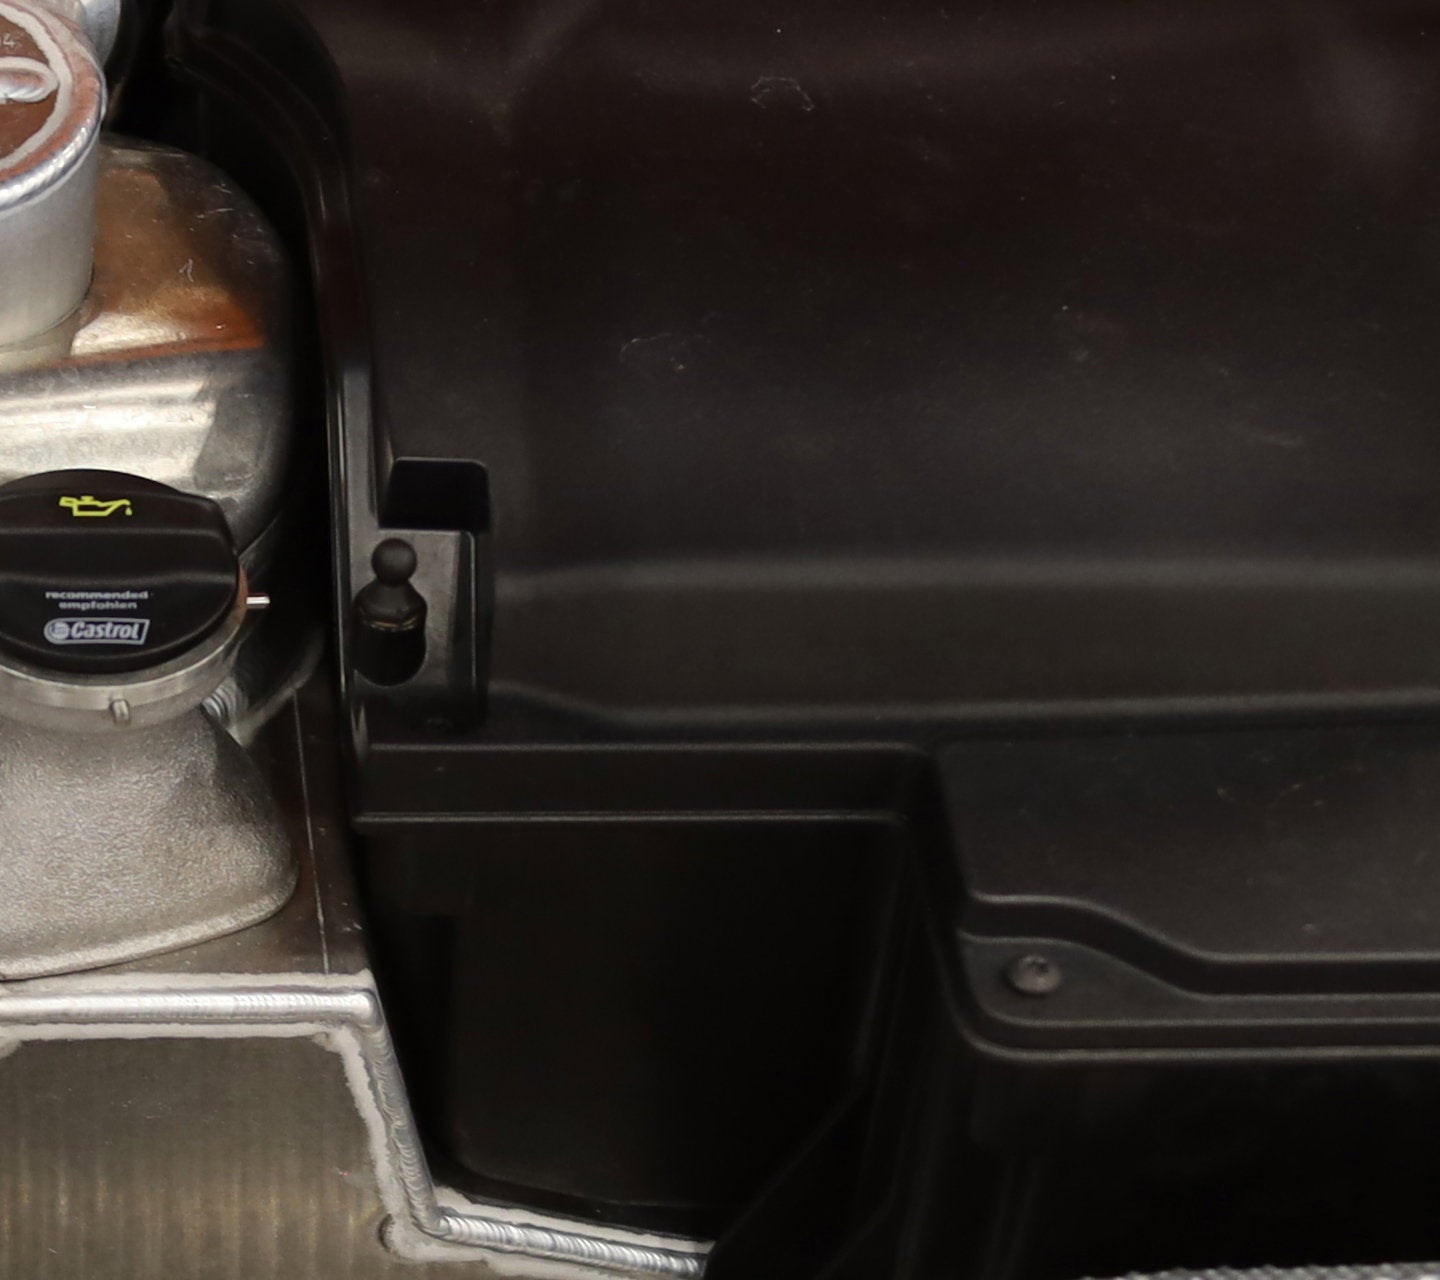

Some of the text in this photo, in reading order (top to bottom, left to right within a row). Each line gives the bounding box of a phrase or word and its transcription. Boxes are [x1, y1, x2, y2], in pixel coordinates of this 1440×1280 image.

[44, 590, 149, 600] recommended
[58, 601, 138, 611] empfohlen
[70, 621, 140, 640] Castrol
